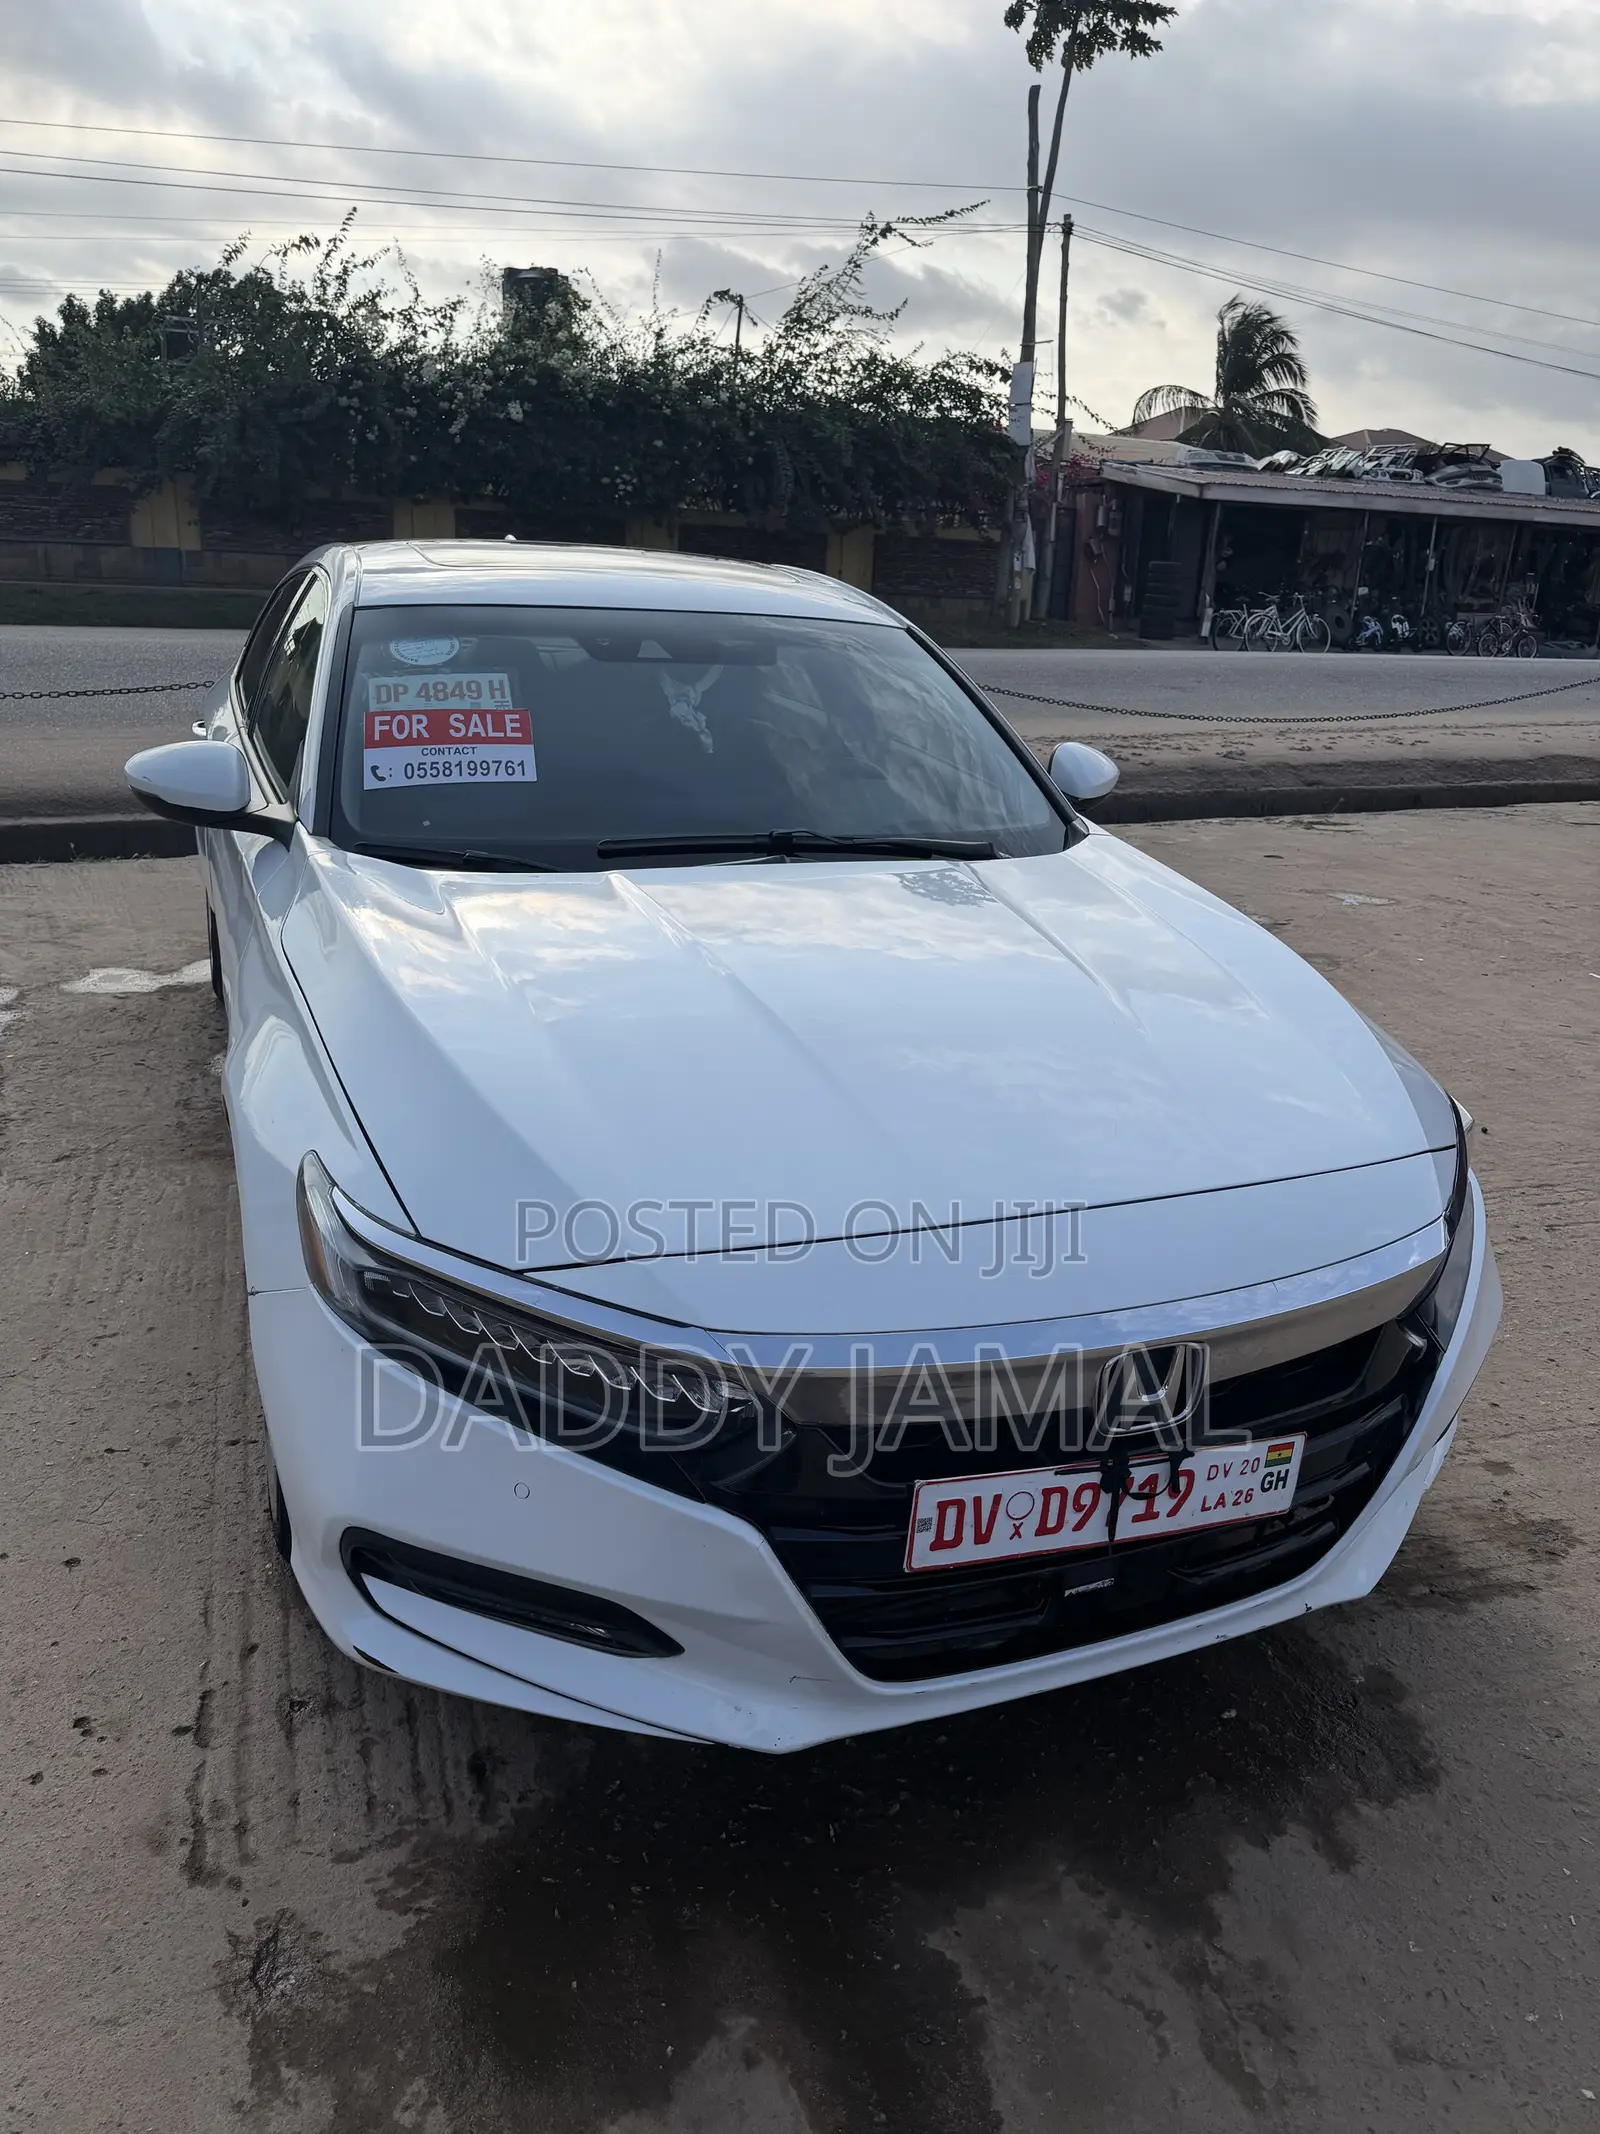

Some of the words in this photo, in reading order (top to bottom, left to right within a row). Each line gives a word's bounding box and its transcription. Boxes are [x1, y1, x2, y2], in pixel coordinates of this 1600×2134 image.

[374, 683, 410, 704] DP
[415, 680, 483, 702] 4849
[488, 679, 507, 699] H
[374, 714, 430, 740] FOR
[449, 713, 523, 737] SALE
[421, 746, 478, 756] CONTACT
[404, 760, 526, 780] 0558199761
[1206, 1462, 1234, 1481] DV
[1239, 1457, 1261, 1476] 20
[1260, 1468, 1290, 1493] GH
[1200, 1492, 1226, 1512] LA
[1232, 1487, 1255, 1507] 26
[929, 1493, 1003, 1551] DV
